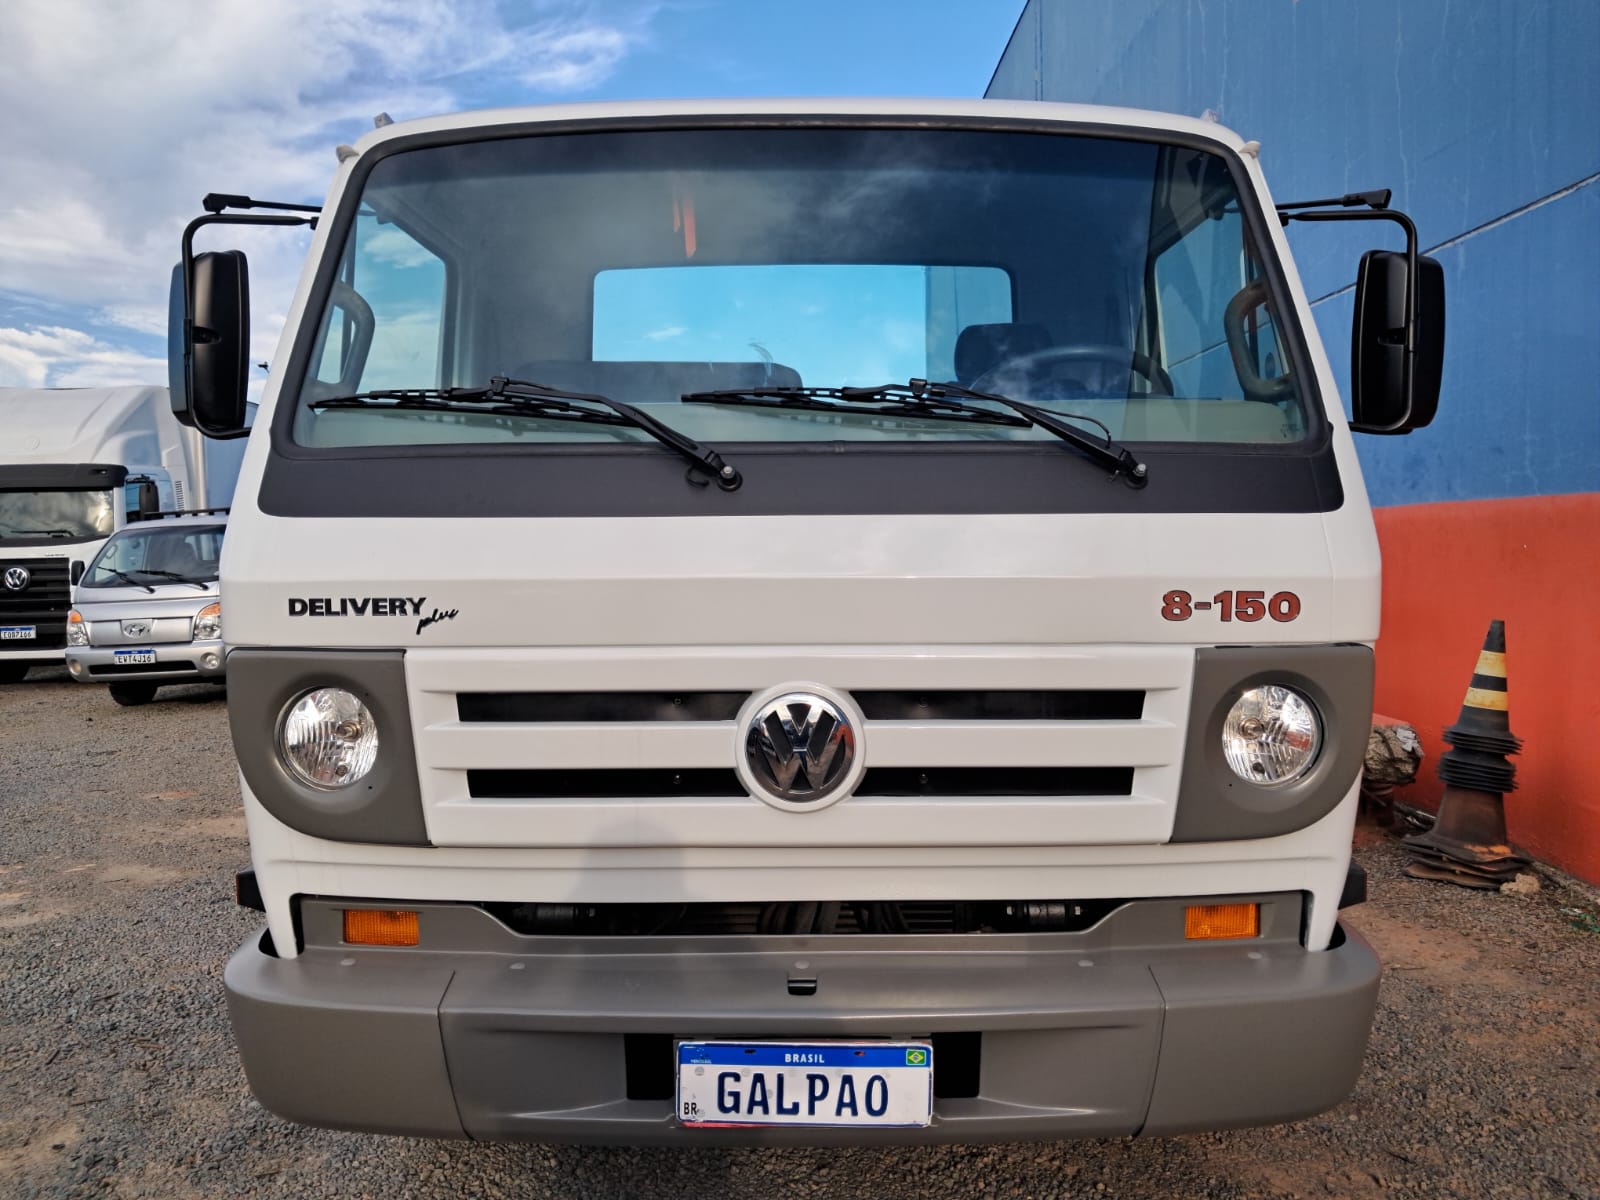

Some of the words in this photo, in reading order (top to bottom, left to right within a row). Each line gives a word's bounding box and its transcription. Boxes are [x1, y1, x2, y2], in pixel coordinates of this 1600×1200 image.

[288, 597, 426, 616] DELIVERY
[1161, 589, 1301, 622] 8-150
[416, 608, 459, 635] plus
[745, 692, 856, 803] VW
[784, 1053, 825, 1063] BRASIL
[717, 1071, 889, 1117] GALPAO
[683, 1102, 698, 1116] BR
